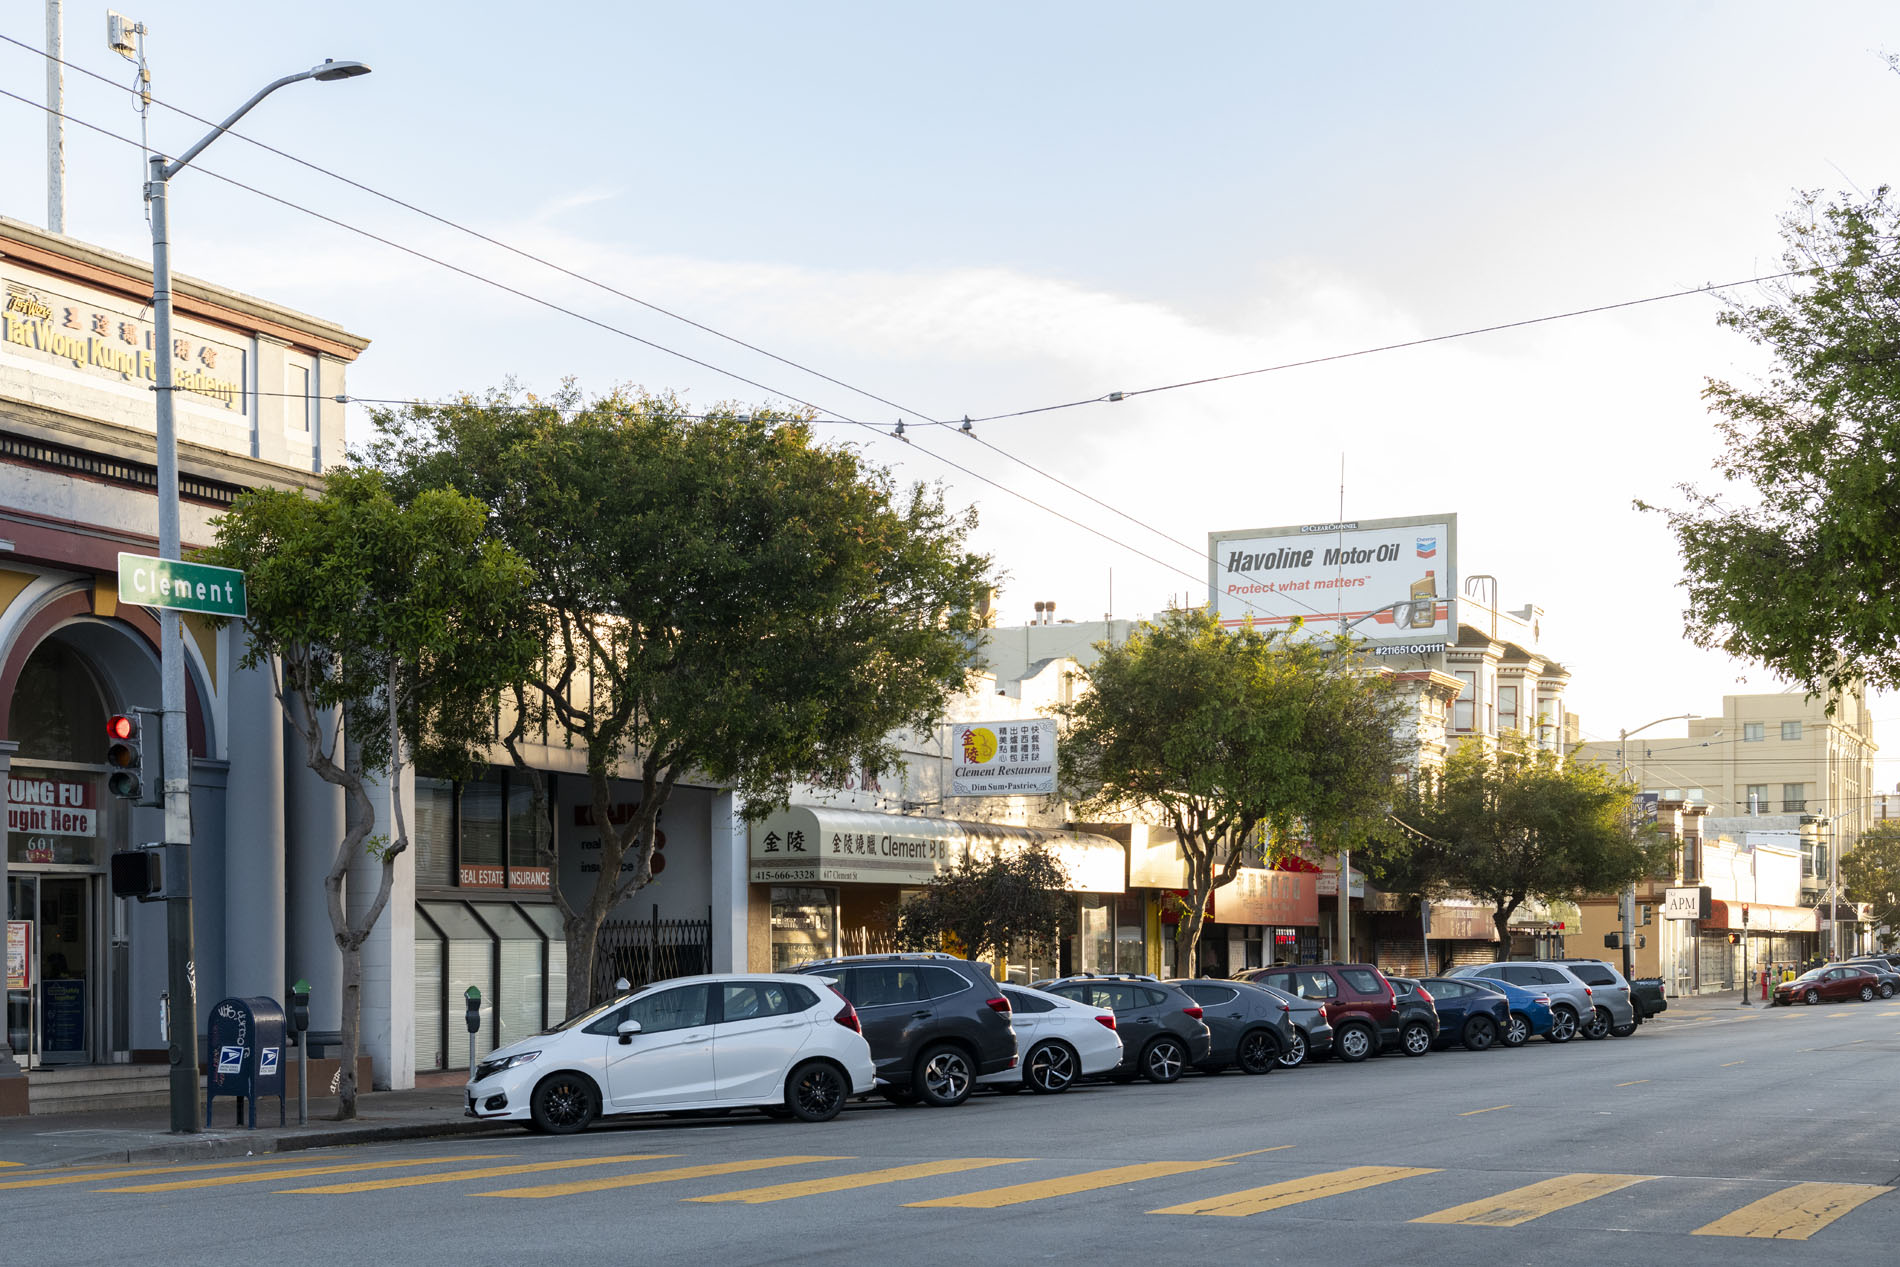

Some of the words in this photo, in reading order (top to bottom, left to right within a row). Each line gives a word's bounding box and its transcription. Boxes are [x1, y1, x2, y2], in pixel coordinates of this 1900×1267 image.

[2, 311, 34, 348] Tat
[36, 319, 88, 369] Wong
[89, 337, 136, 382] Kung
[174, 367, 238, 409] cademy
[1228, 547, 1314, 573] Havoline
[133, 568, 233, 604] Clement
[1228, 582, 1275, 595] Protect
[1278, 580, 1310, 592] what
[961, 729, 981, 764] 金陵
[955, 767, 995, 778] Clement
[997, 765, 1052, 776] Restaurant
[59, 783, 83, 807] FU
[971, 783, 987, 792] Dim
[51, 809, 88, 833] Here
[28, 836, 55, 852] 601
[581, 838, 601, 850] real
[763, 830, 807, 853] 金陵
[881, 835, 926, 859] Clement
[479, 870, 504, 884] ESTATE
[755, 870, 815, 880] 415-666-3328
[833, 871, 852, 880] Clement
[1670, 897, 1695, 910] APM
